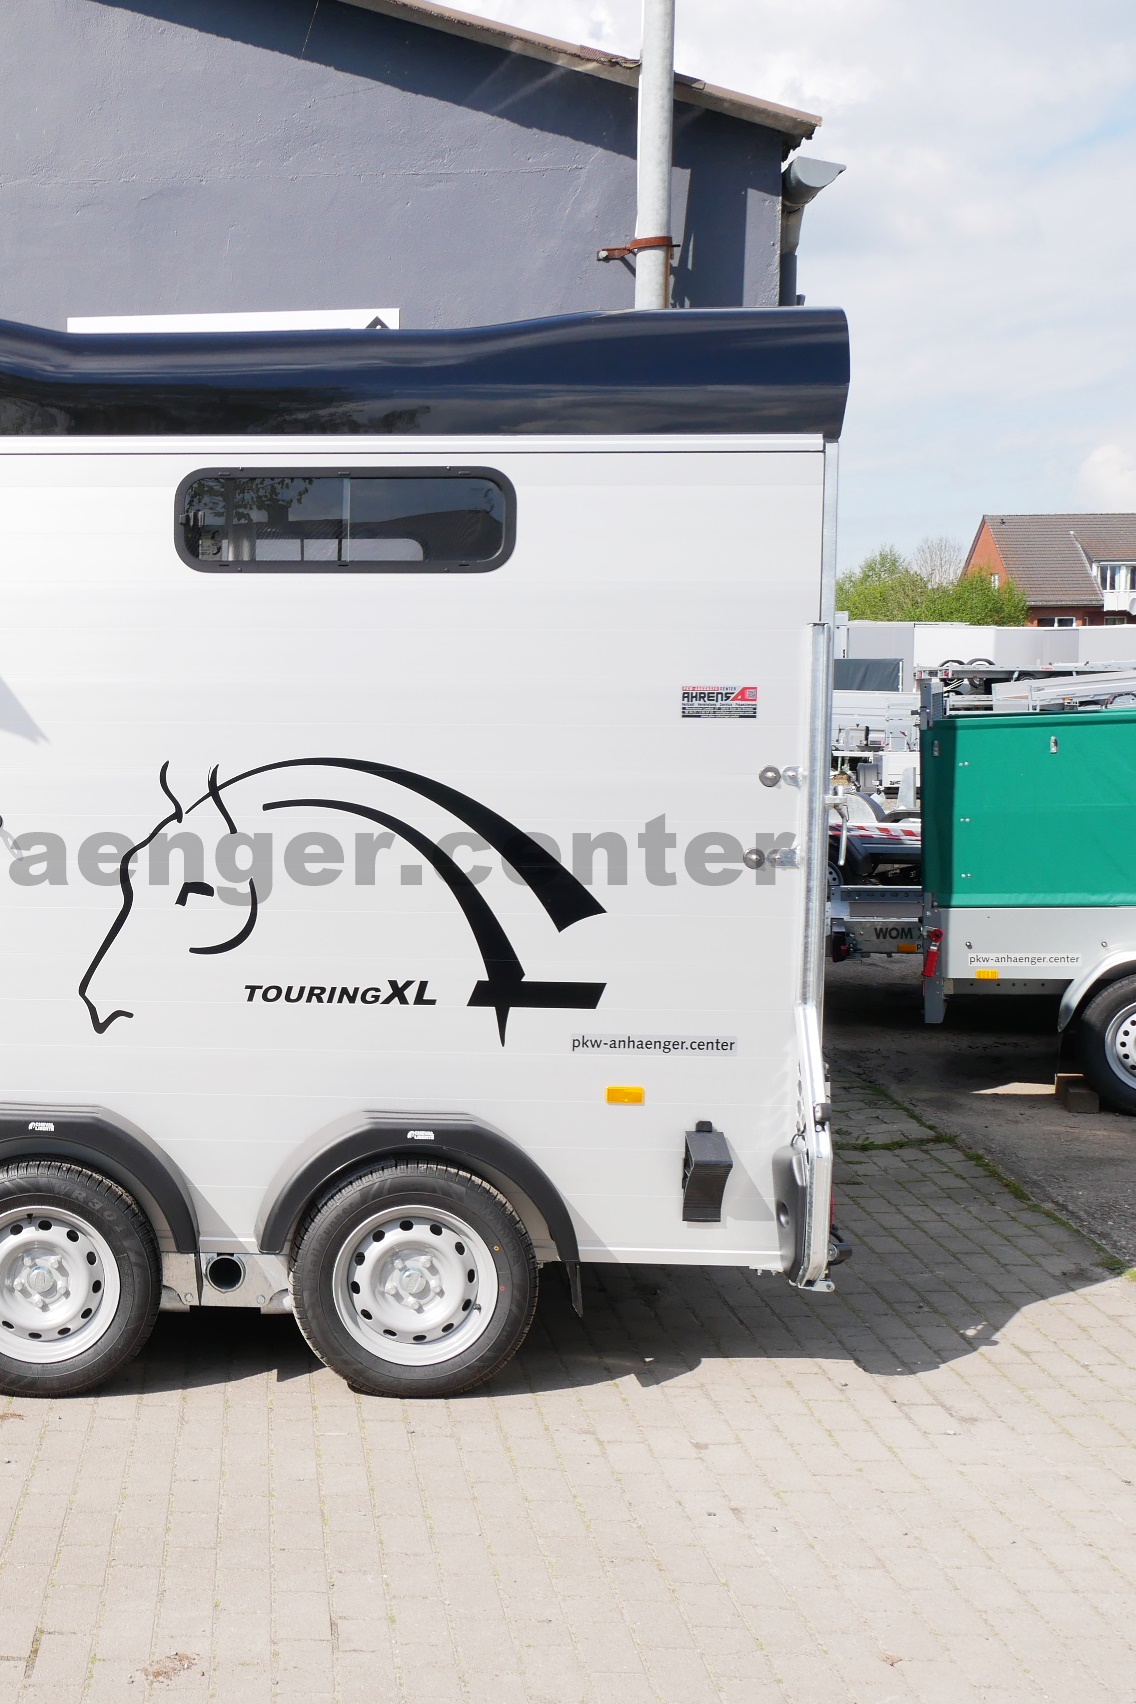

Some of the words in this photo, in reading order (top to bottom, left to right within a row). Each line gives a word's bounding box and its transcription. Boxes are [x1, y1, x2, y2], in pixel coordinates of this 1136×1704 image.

[682, 692, 736, 702] AHRENS
[969, 954, 1080, 966] pkw-anhaenger.center
[244, 979, 438, 1006] TOURINGXL
[572, 1035, 735, 1053] pkw-anhaenger.center
